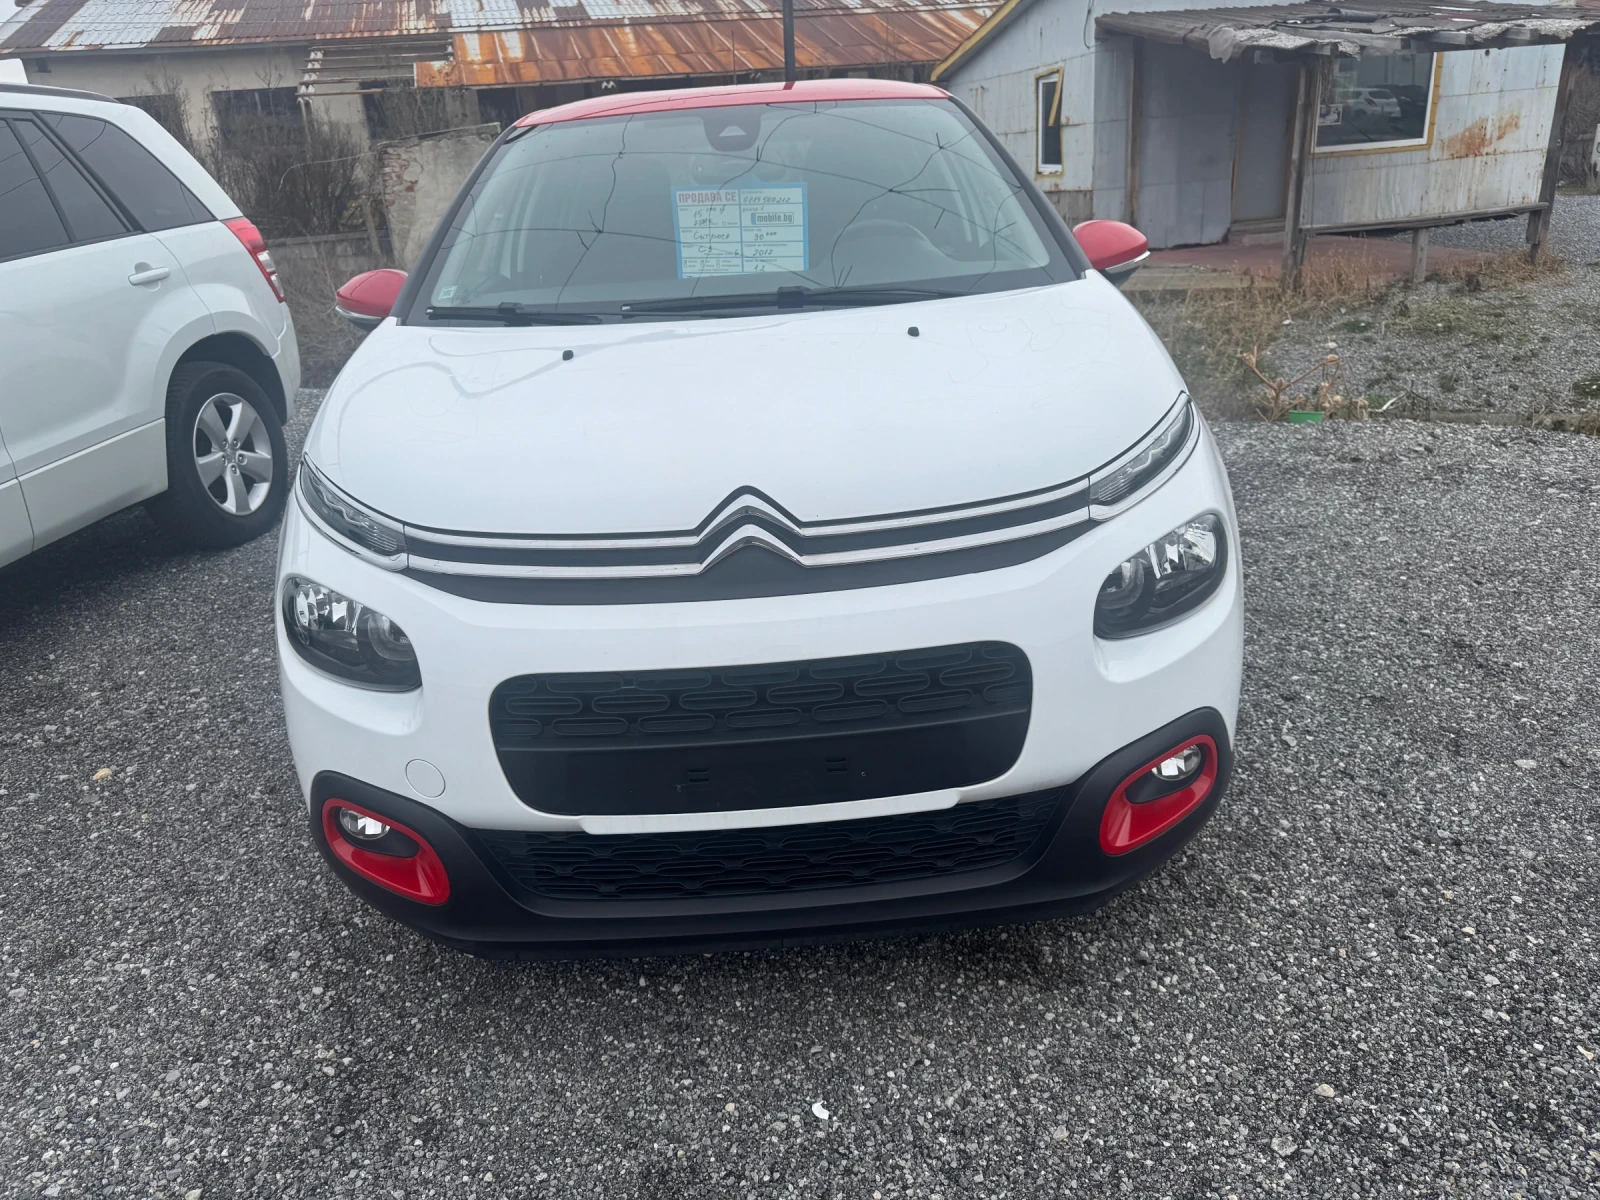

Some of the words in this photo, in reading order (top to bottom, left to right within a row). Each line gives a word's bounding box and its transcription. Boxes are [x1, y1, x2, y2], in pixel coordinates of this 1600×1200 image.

[678, 191, 723, 204] ПРОДАВА
[725, 191, 737, 202] СЕ
[756, 213, 793, 223] mobile.bg
